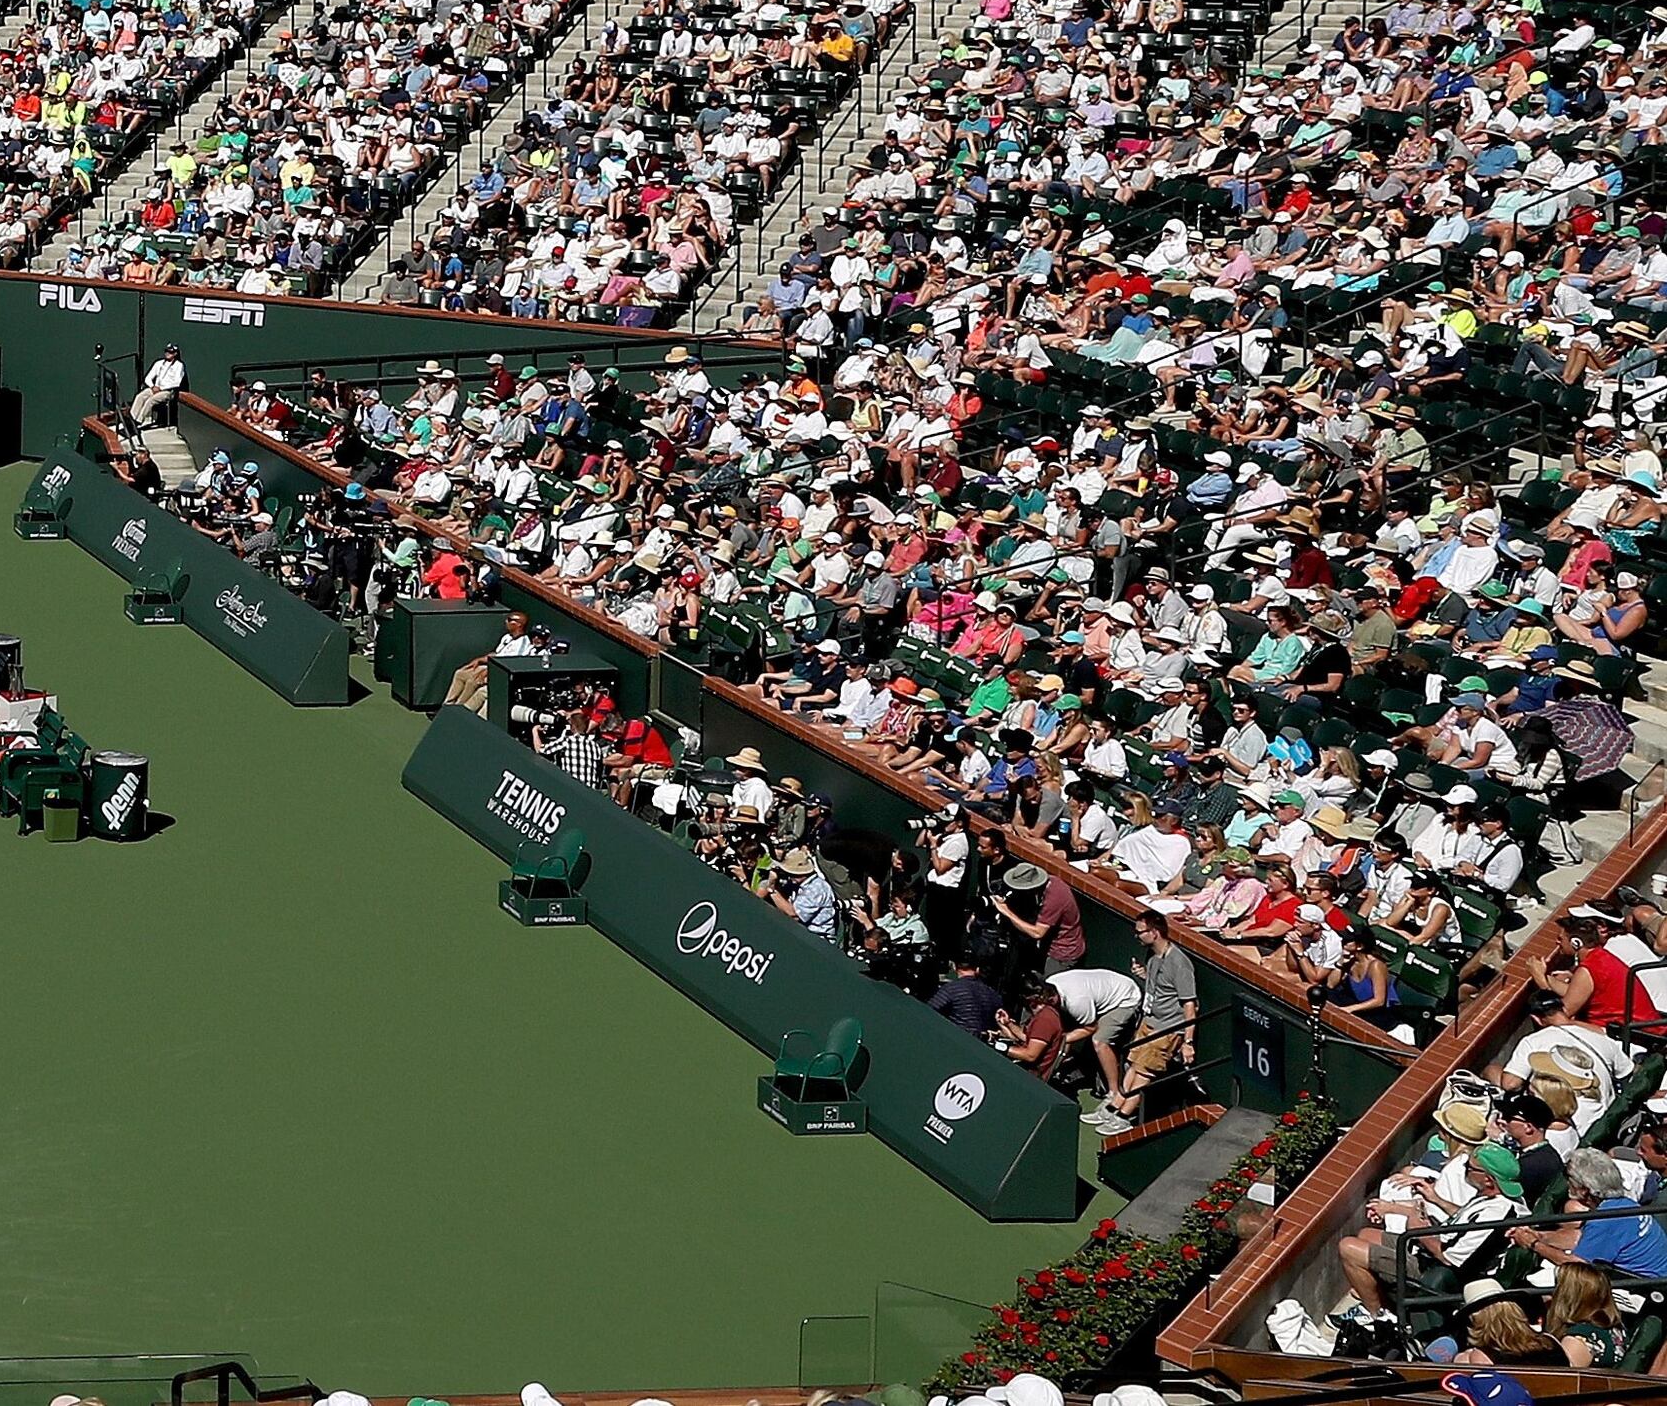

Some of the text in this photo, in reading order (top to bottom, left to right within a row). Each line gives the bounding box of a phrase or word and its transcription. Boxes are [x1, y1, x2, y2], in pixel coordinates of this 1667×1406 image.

[40, 283, 102, 312] FILA
[182, 297, 266, 326] ESPN
[494, 770, 566, 834] TENNIS
[486, 798, 551, 845] WAREHOUSE
[708, 926, 774, 985] pepsi
[1243, 1006, 1270, 1029] SERVE
[1244, 1039, 1270, 1077] 16
[944, 1080, 974, 1113] WTA
[806, 1122, 855, 1130] BNP PARIBAS
